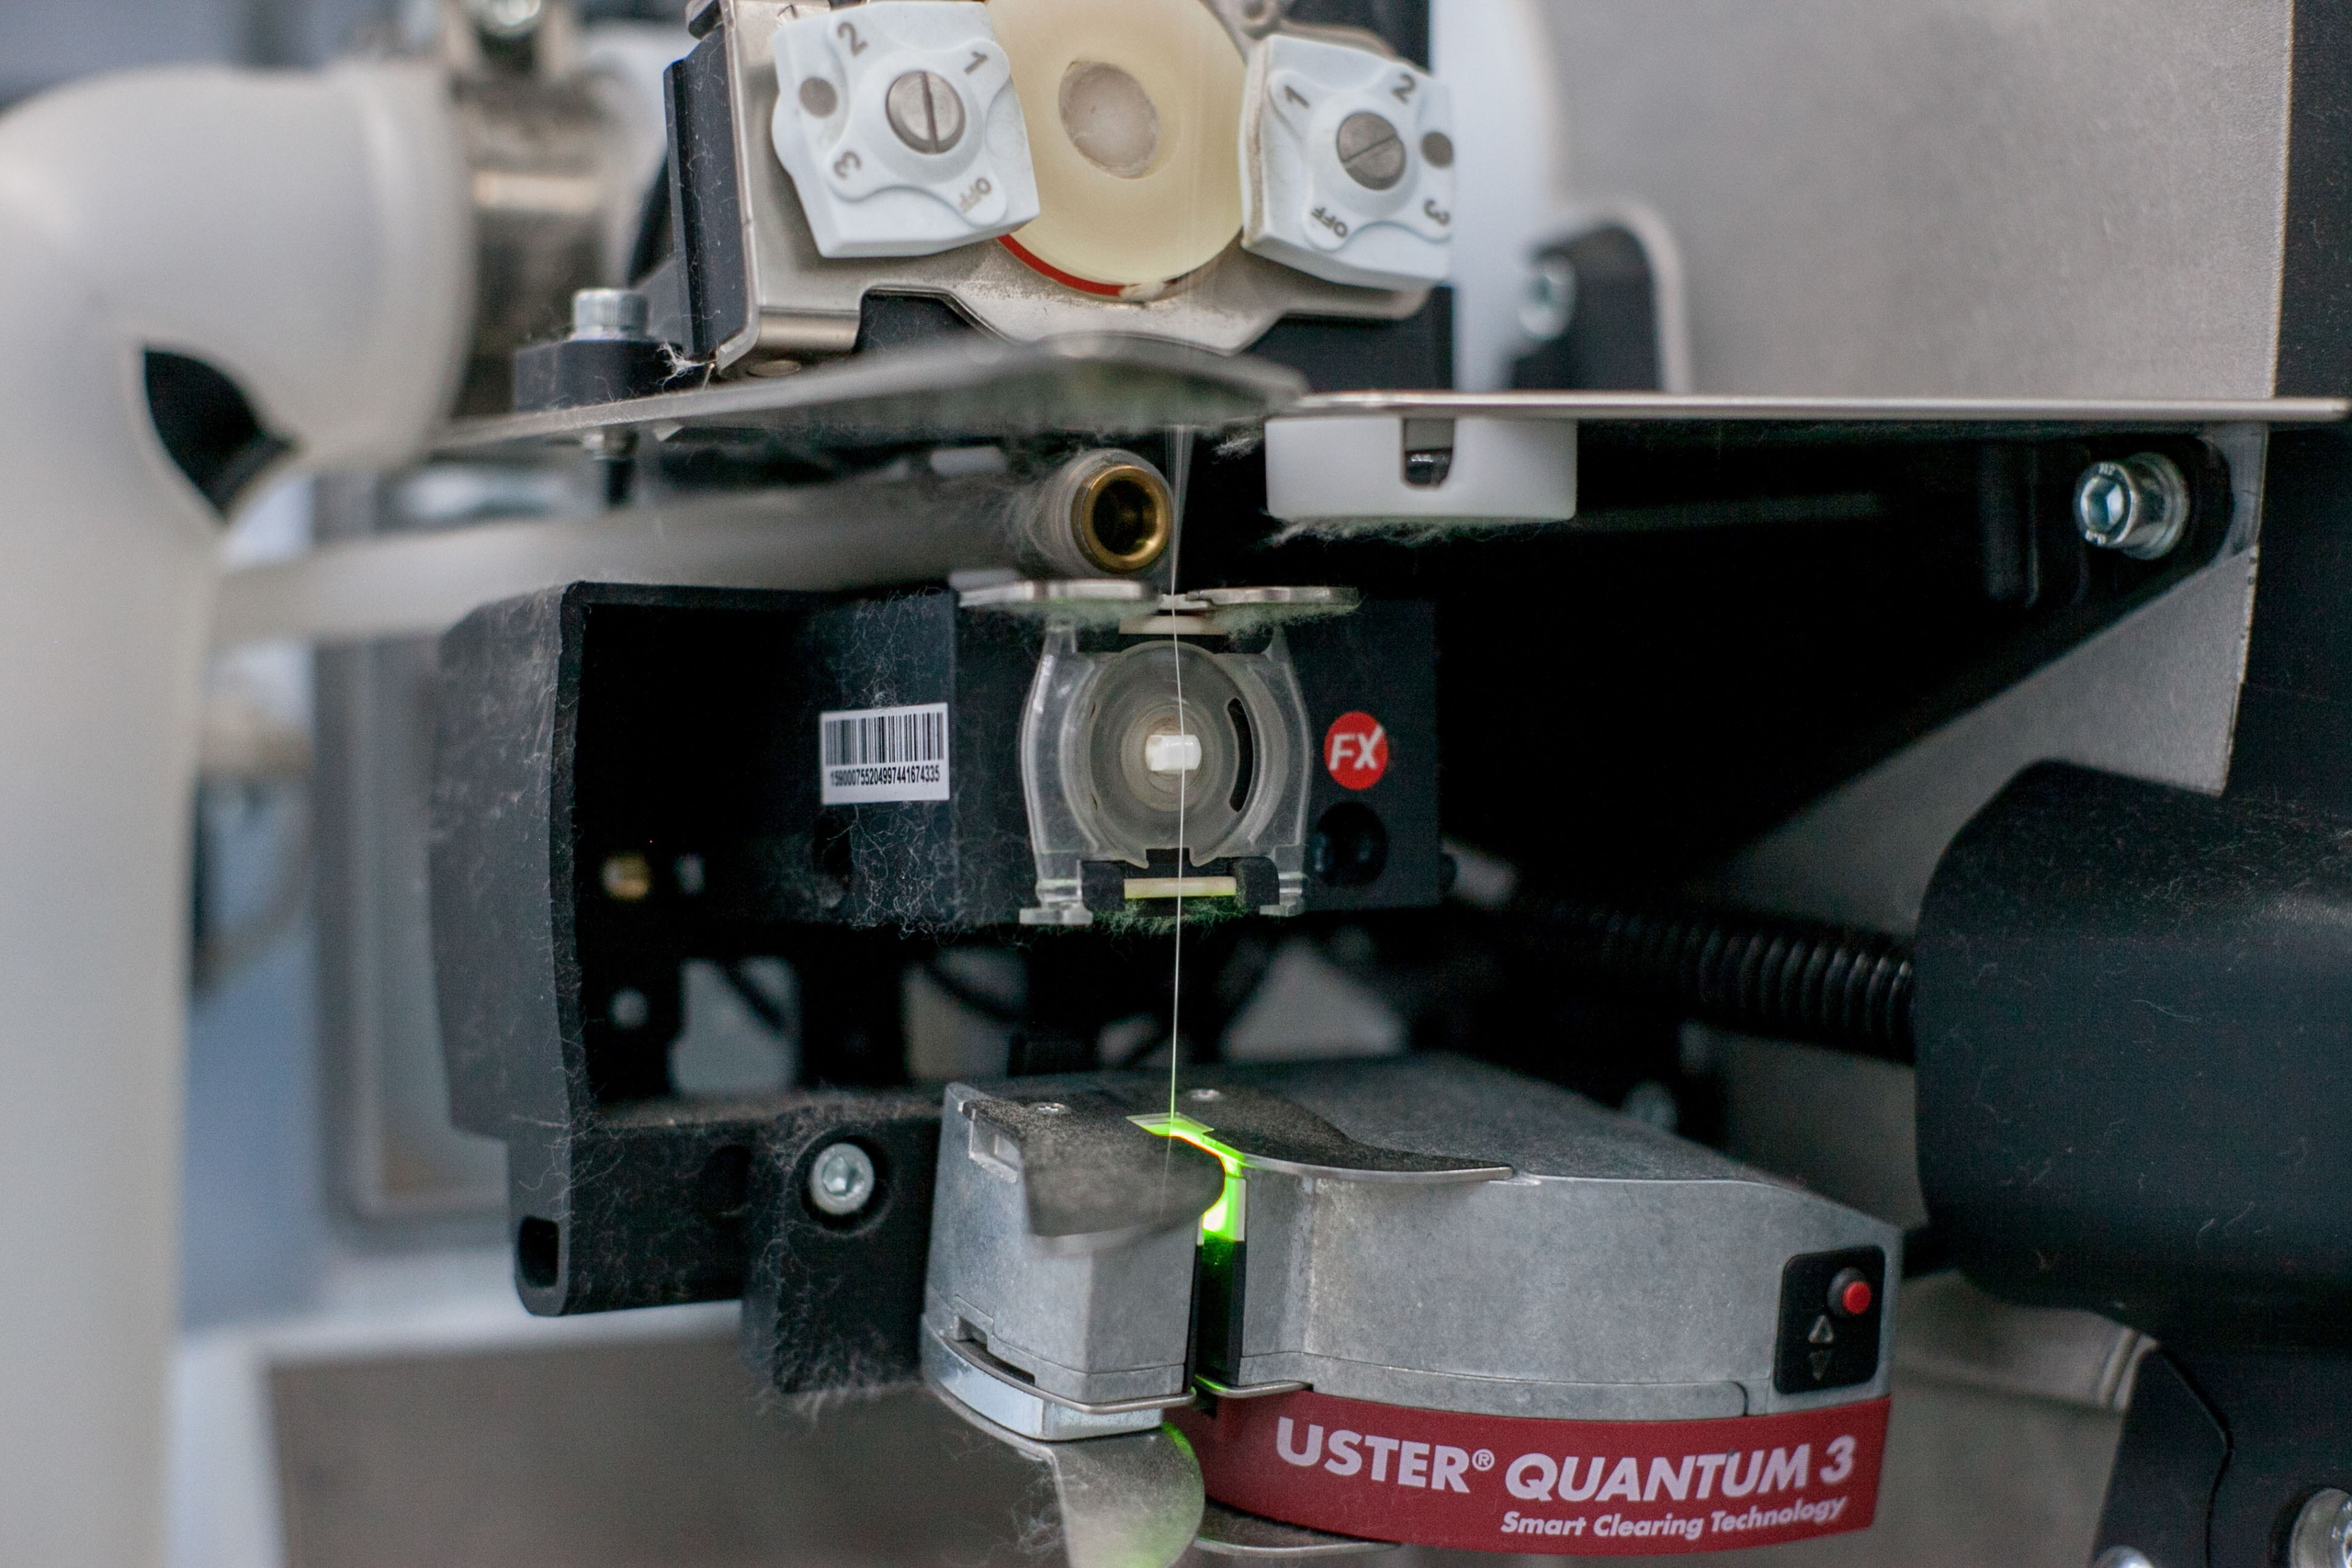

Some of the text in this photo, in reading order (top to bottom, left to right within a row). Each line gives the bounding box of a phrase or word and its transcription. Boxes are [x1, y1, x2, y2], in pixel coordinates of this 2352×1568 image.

[836, 22, 868, 56] 2
[964, 51, 989, 75] 1
[1283, 85, 1311, 108] 1
[1389, 73, 1418, 105] 2
[832, 150, 862, 180] 3
[1310, 206, 1349, 239] OFF
[1423, 198, 1451, 227] 3
[1329, 725, 1384, 771] FX
[1505, 1443, 1811, 1502] QUANTUM
[1819, 1435, 1856, 1483] 3
[1500, 1495, 1848, 1541] Smart Clearing Technology
